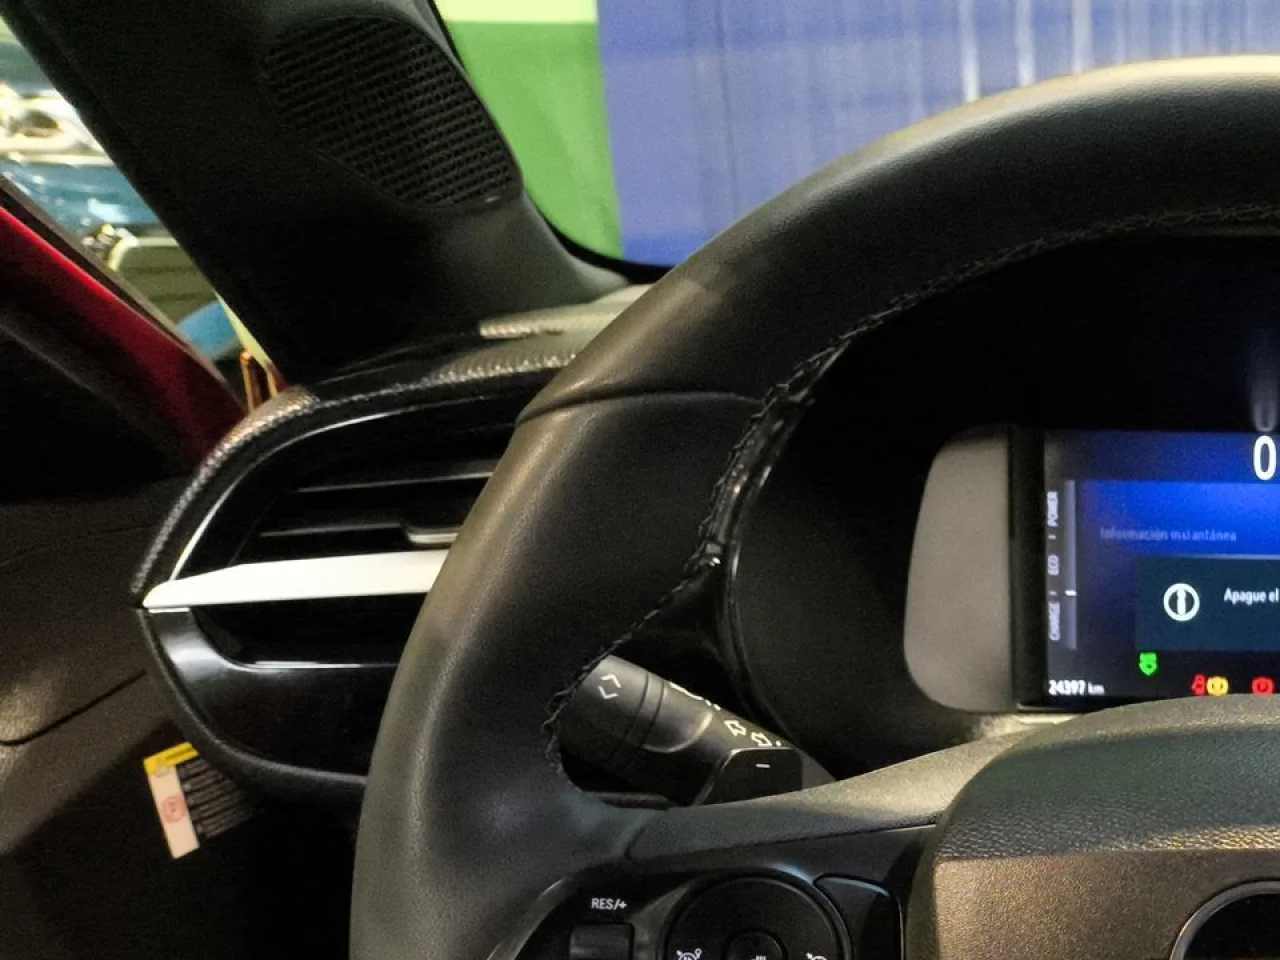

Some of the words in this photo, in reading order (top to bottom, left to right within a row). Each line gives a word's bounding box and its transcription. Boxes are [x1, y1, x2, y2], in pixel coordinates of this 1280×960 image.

[1253, 435, 1277, 481] 0
[1223, 587, 1266, 606] Apague
[1268, 587, 1280, 603] el
[1088, 682, 1105, 696] km
